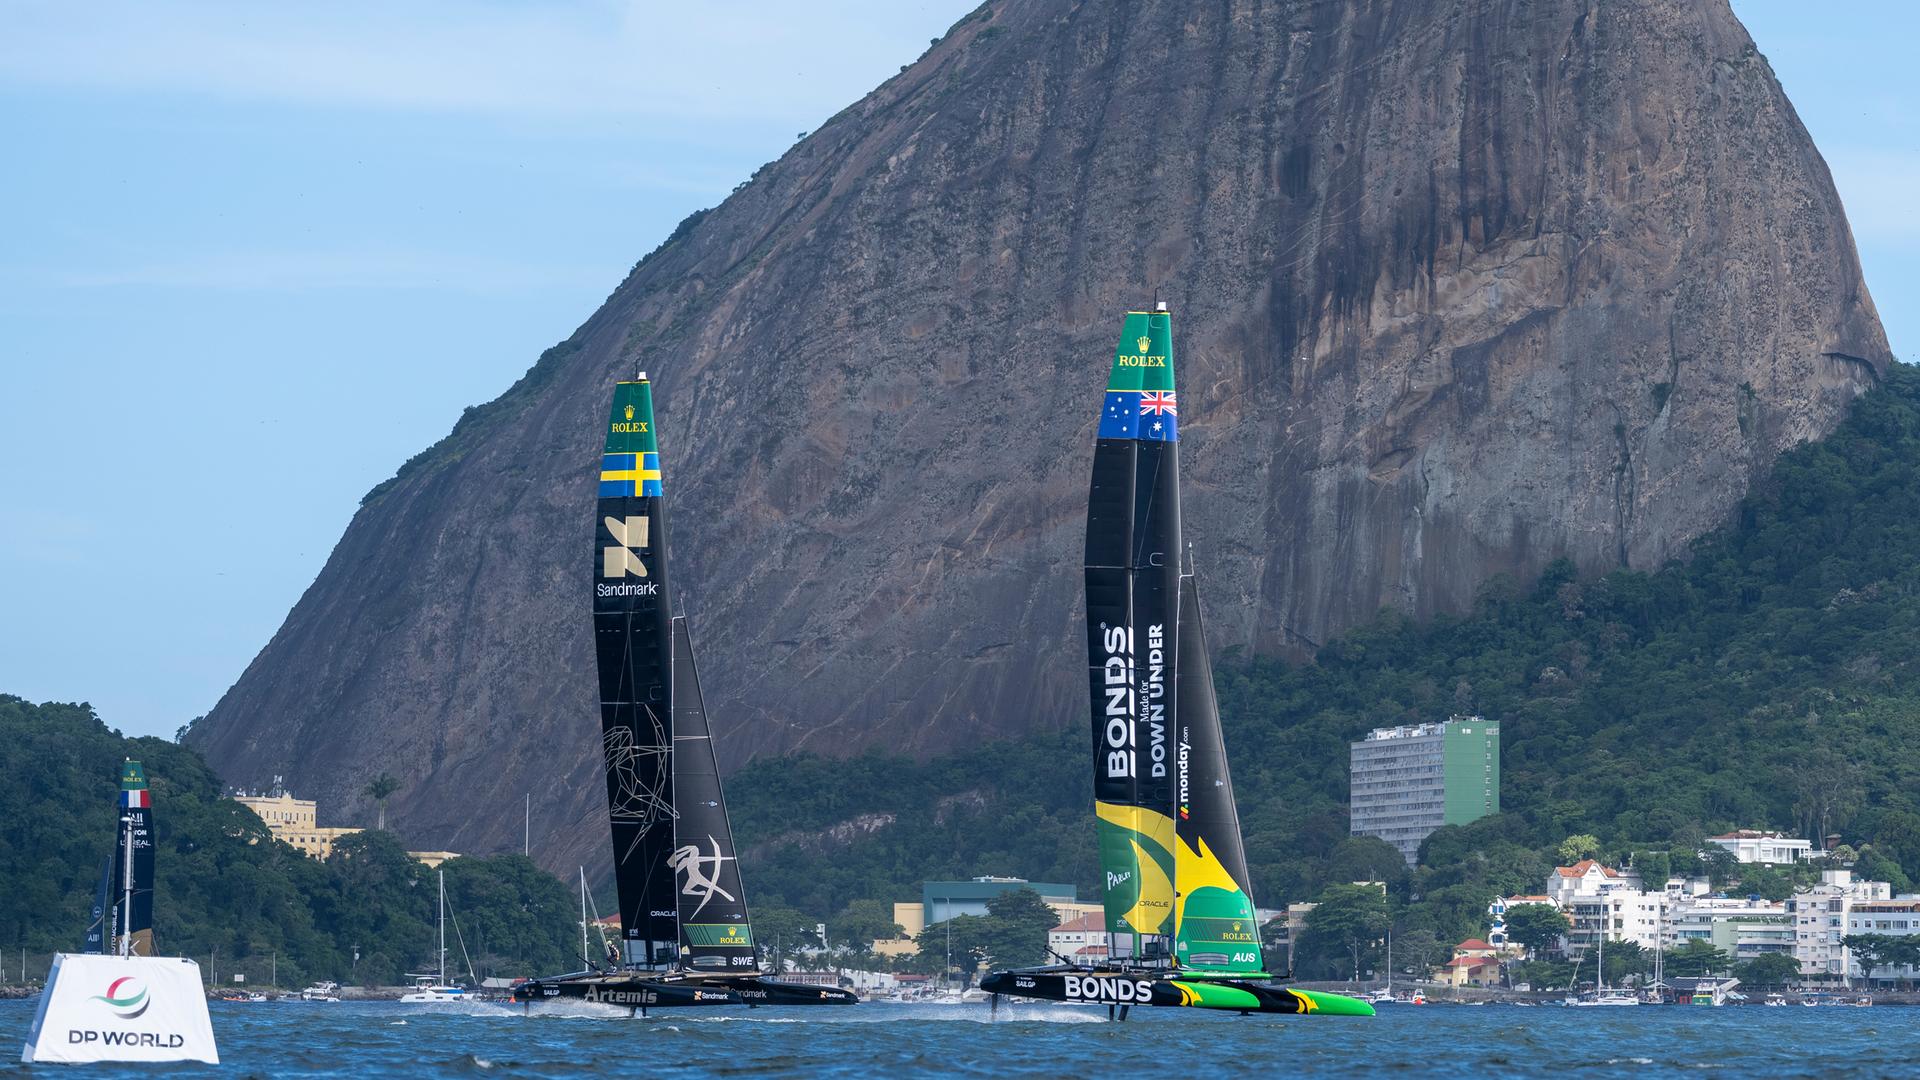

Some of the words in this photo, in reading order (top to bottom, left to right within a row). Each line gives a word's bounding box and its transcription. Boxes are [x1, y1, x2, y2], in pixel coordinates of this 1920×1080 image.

[1118, 355, 1166, 367] ROLEX
[612, 422, 648, 432] ROLEX
[1148, 624, 1164, 698] UNDER
[1140, 680, 1150, 694] for
[1140, 695, 1150, 722] Made
[1150, 704, 1166, 778] DOWN
[1178, 726, 1191, 802] monday.com
[1222, 932, 1252, 940] ROLEX
[732, 956, 754, 966] SWE
[1232, 952, 1256, 962] AUS
[584, 984, 658, 1004] Artemis
[702, 992, 728, 1000] Sandmark
[1064, 976, 1152, 1002] BONDS
[68, 1030, 98, 1044] DP
[102, 1030, 184, 1048] WORLD
